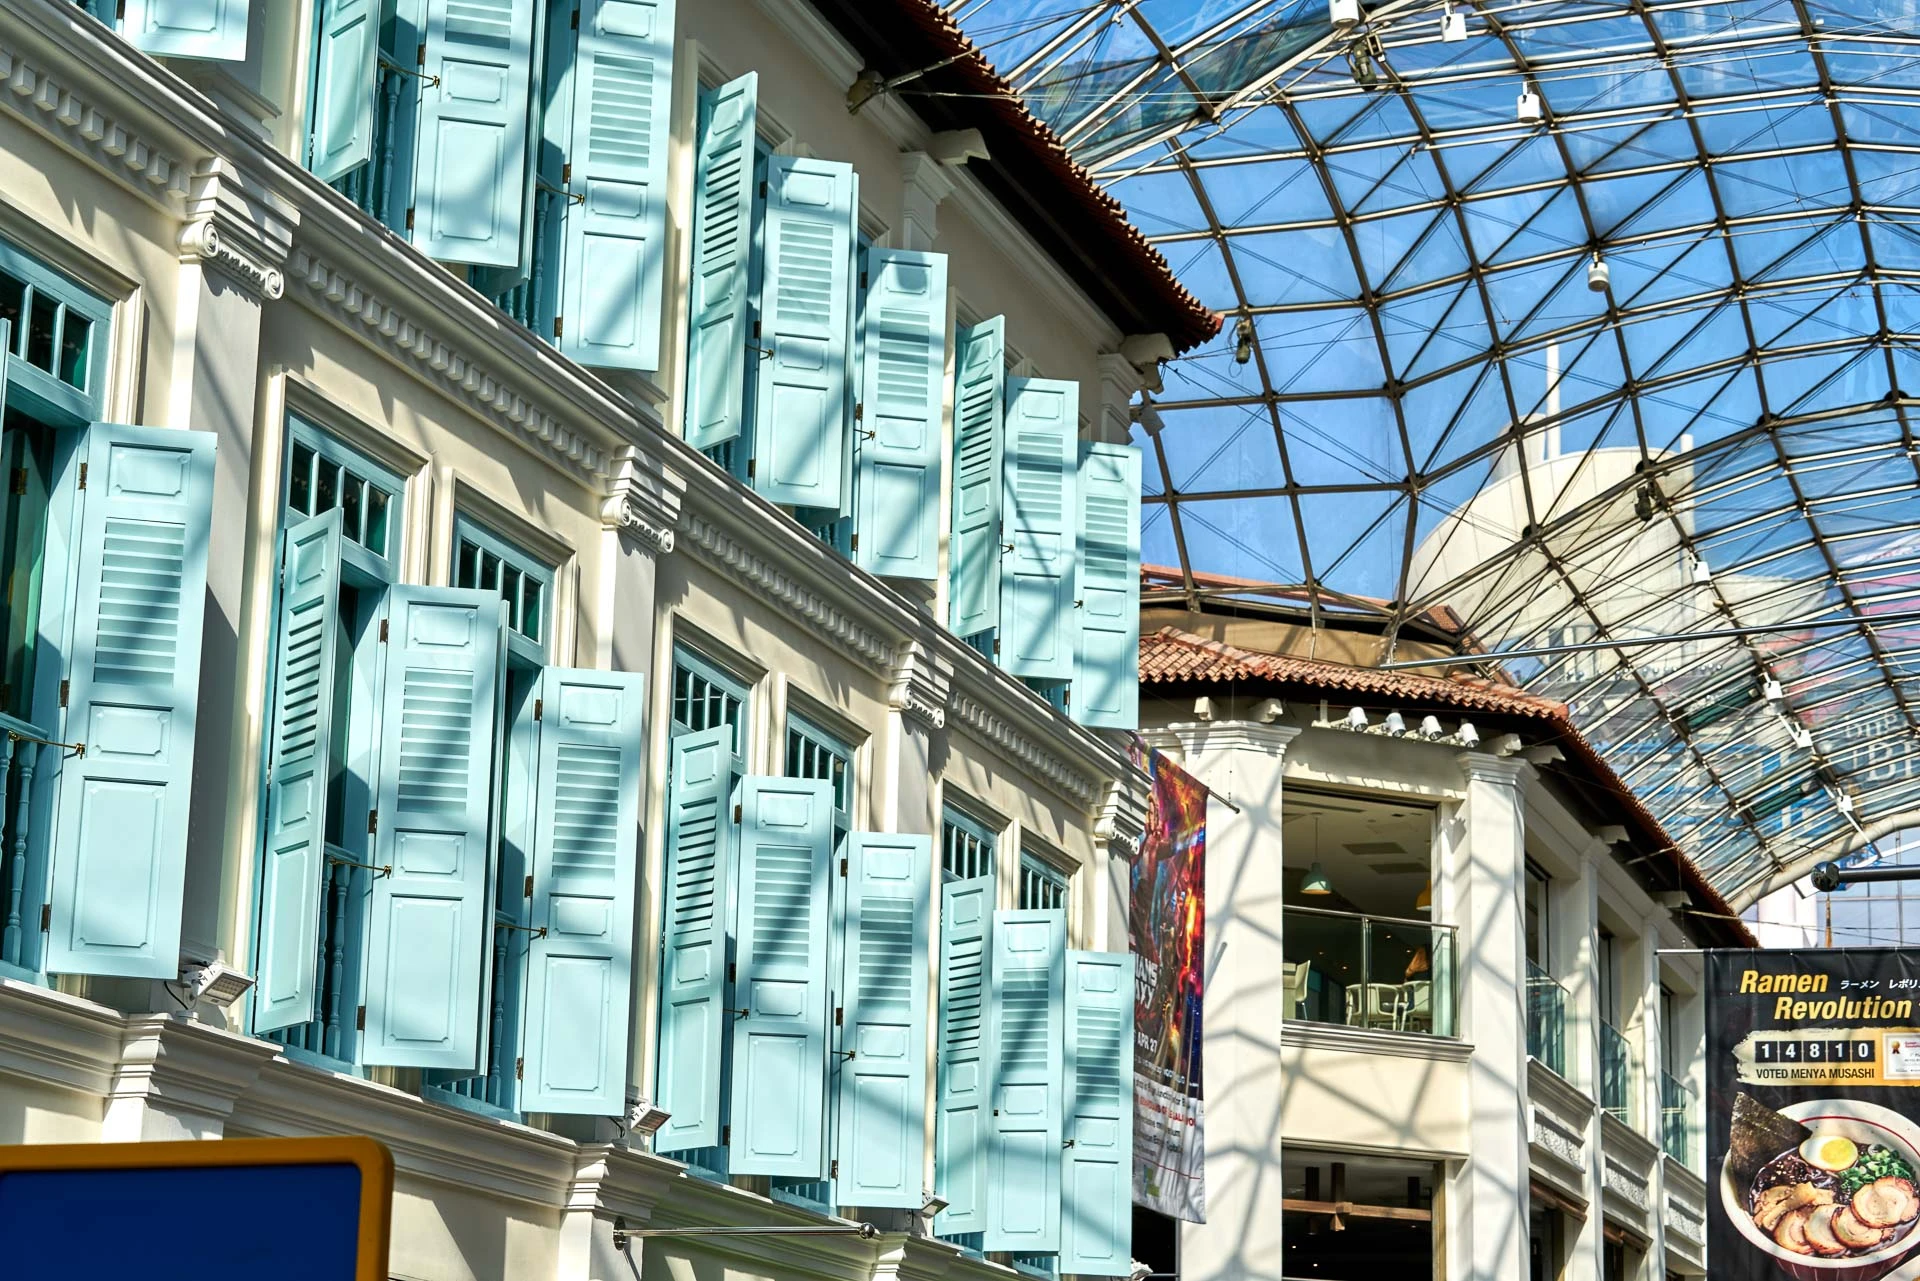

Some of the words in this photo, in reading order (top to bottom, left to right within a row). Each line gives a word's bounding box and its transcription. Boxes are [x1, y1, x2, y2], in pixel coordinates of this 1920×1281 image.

[1740, 970, 1829, 993] Ramen
[1840, 980, 1880, 989] ラーメン
[1888, 979, 1920, 989] レボリ
[1774, 996, 1912, 1020] Revolution
[1756, 1069, 1788, 1079] VOTED
[1791, 1069, 1827, 1079] MENYA
[1829, 1068, 1875, 1079] MUSASHI
